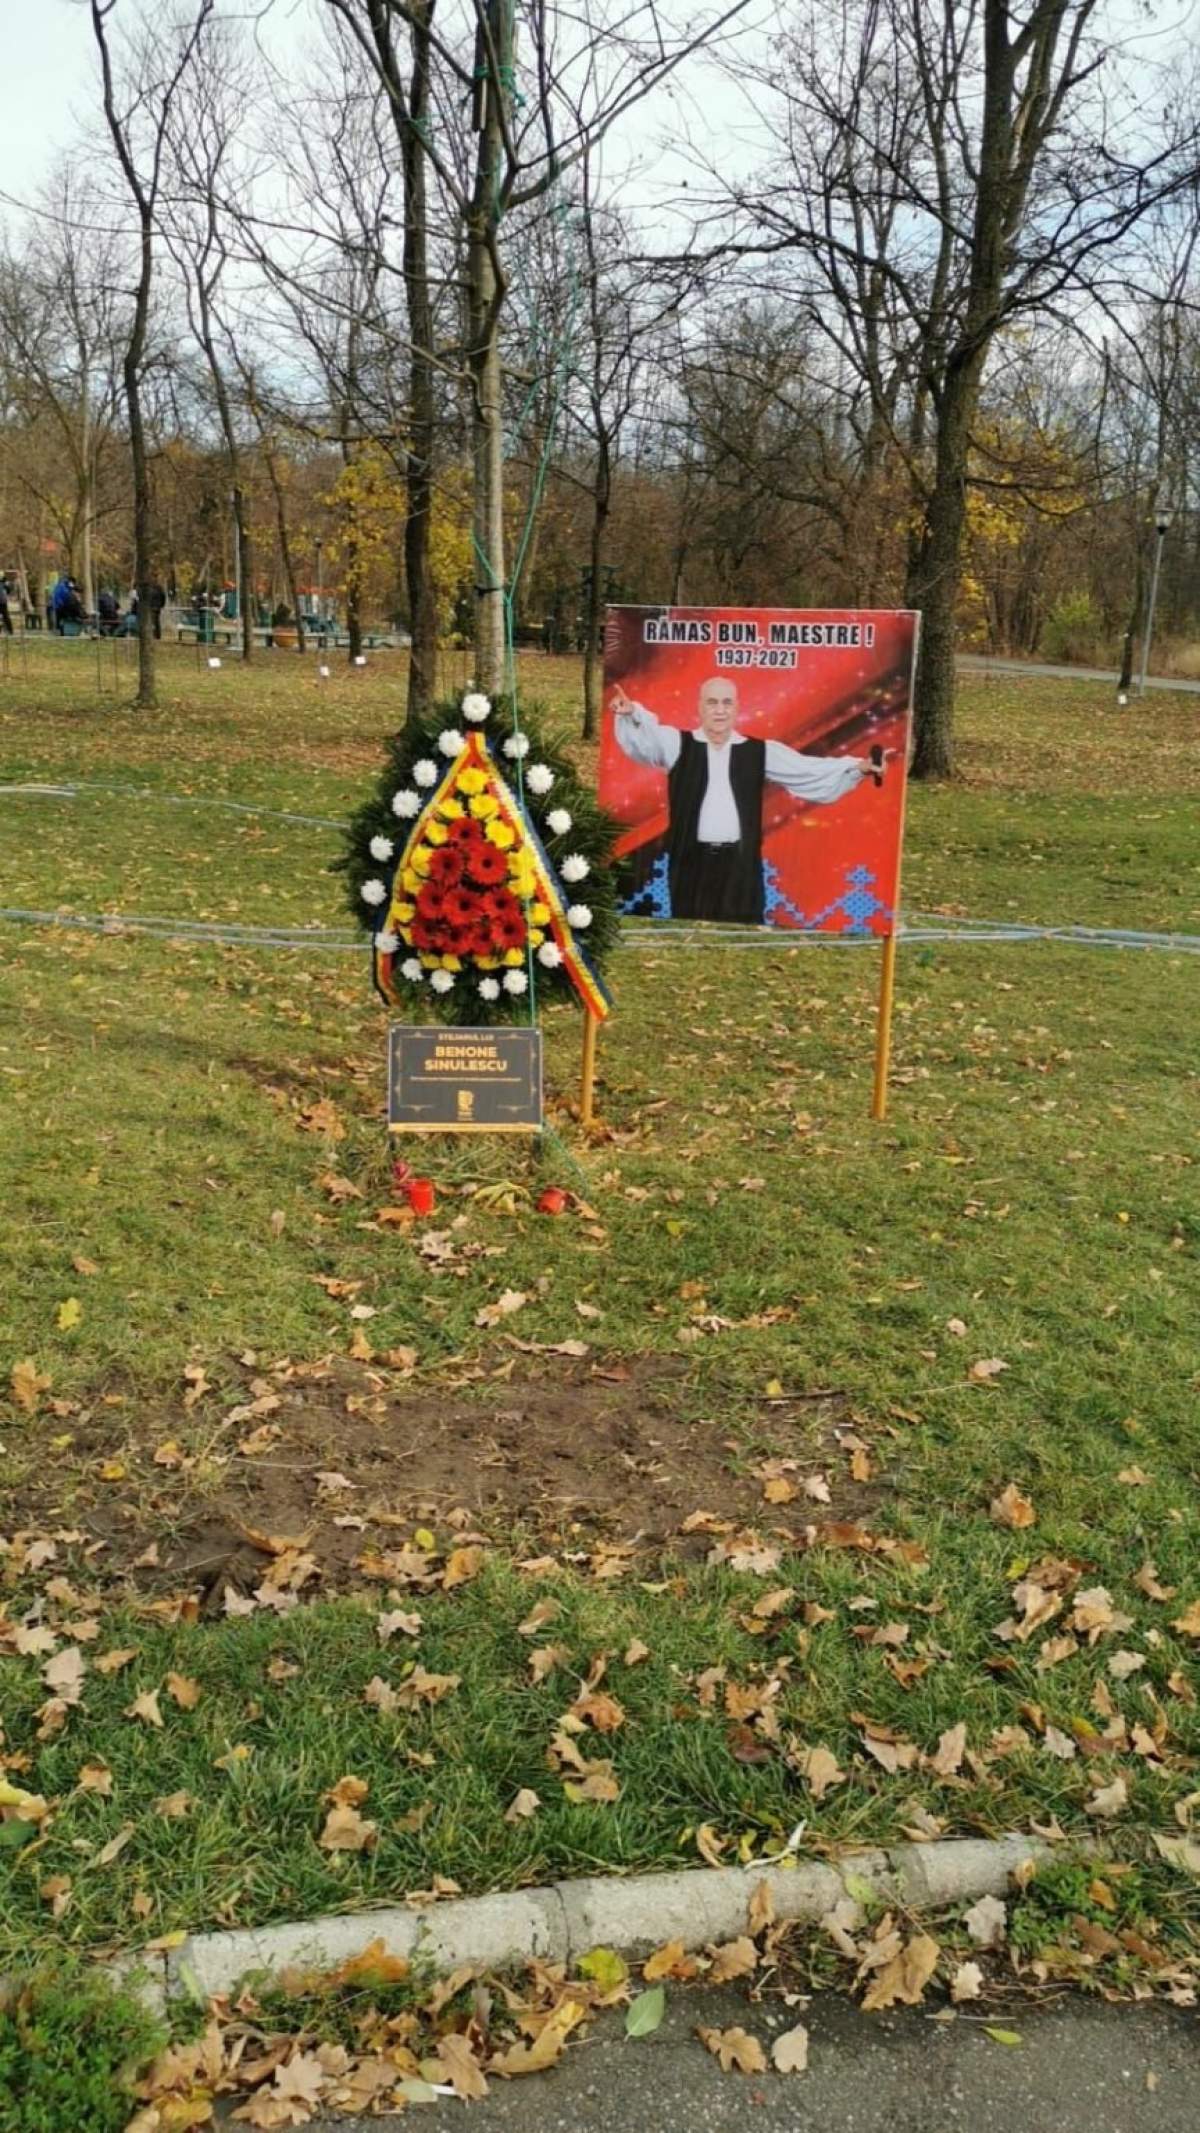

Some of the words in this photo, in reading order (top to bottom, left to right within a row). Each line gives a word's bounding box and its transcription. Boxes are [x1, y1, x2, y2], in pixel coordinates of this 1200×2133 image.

[769, 624, 860, 646] MAESTRE
[716, 648, 796, 667] 1937-2021
[435, 1046, 496, 1058] BENONE
[424, 1059, 507, 1072] SINULESCU
